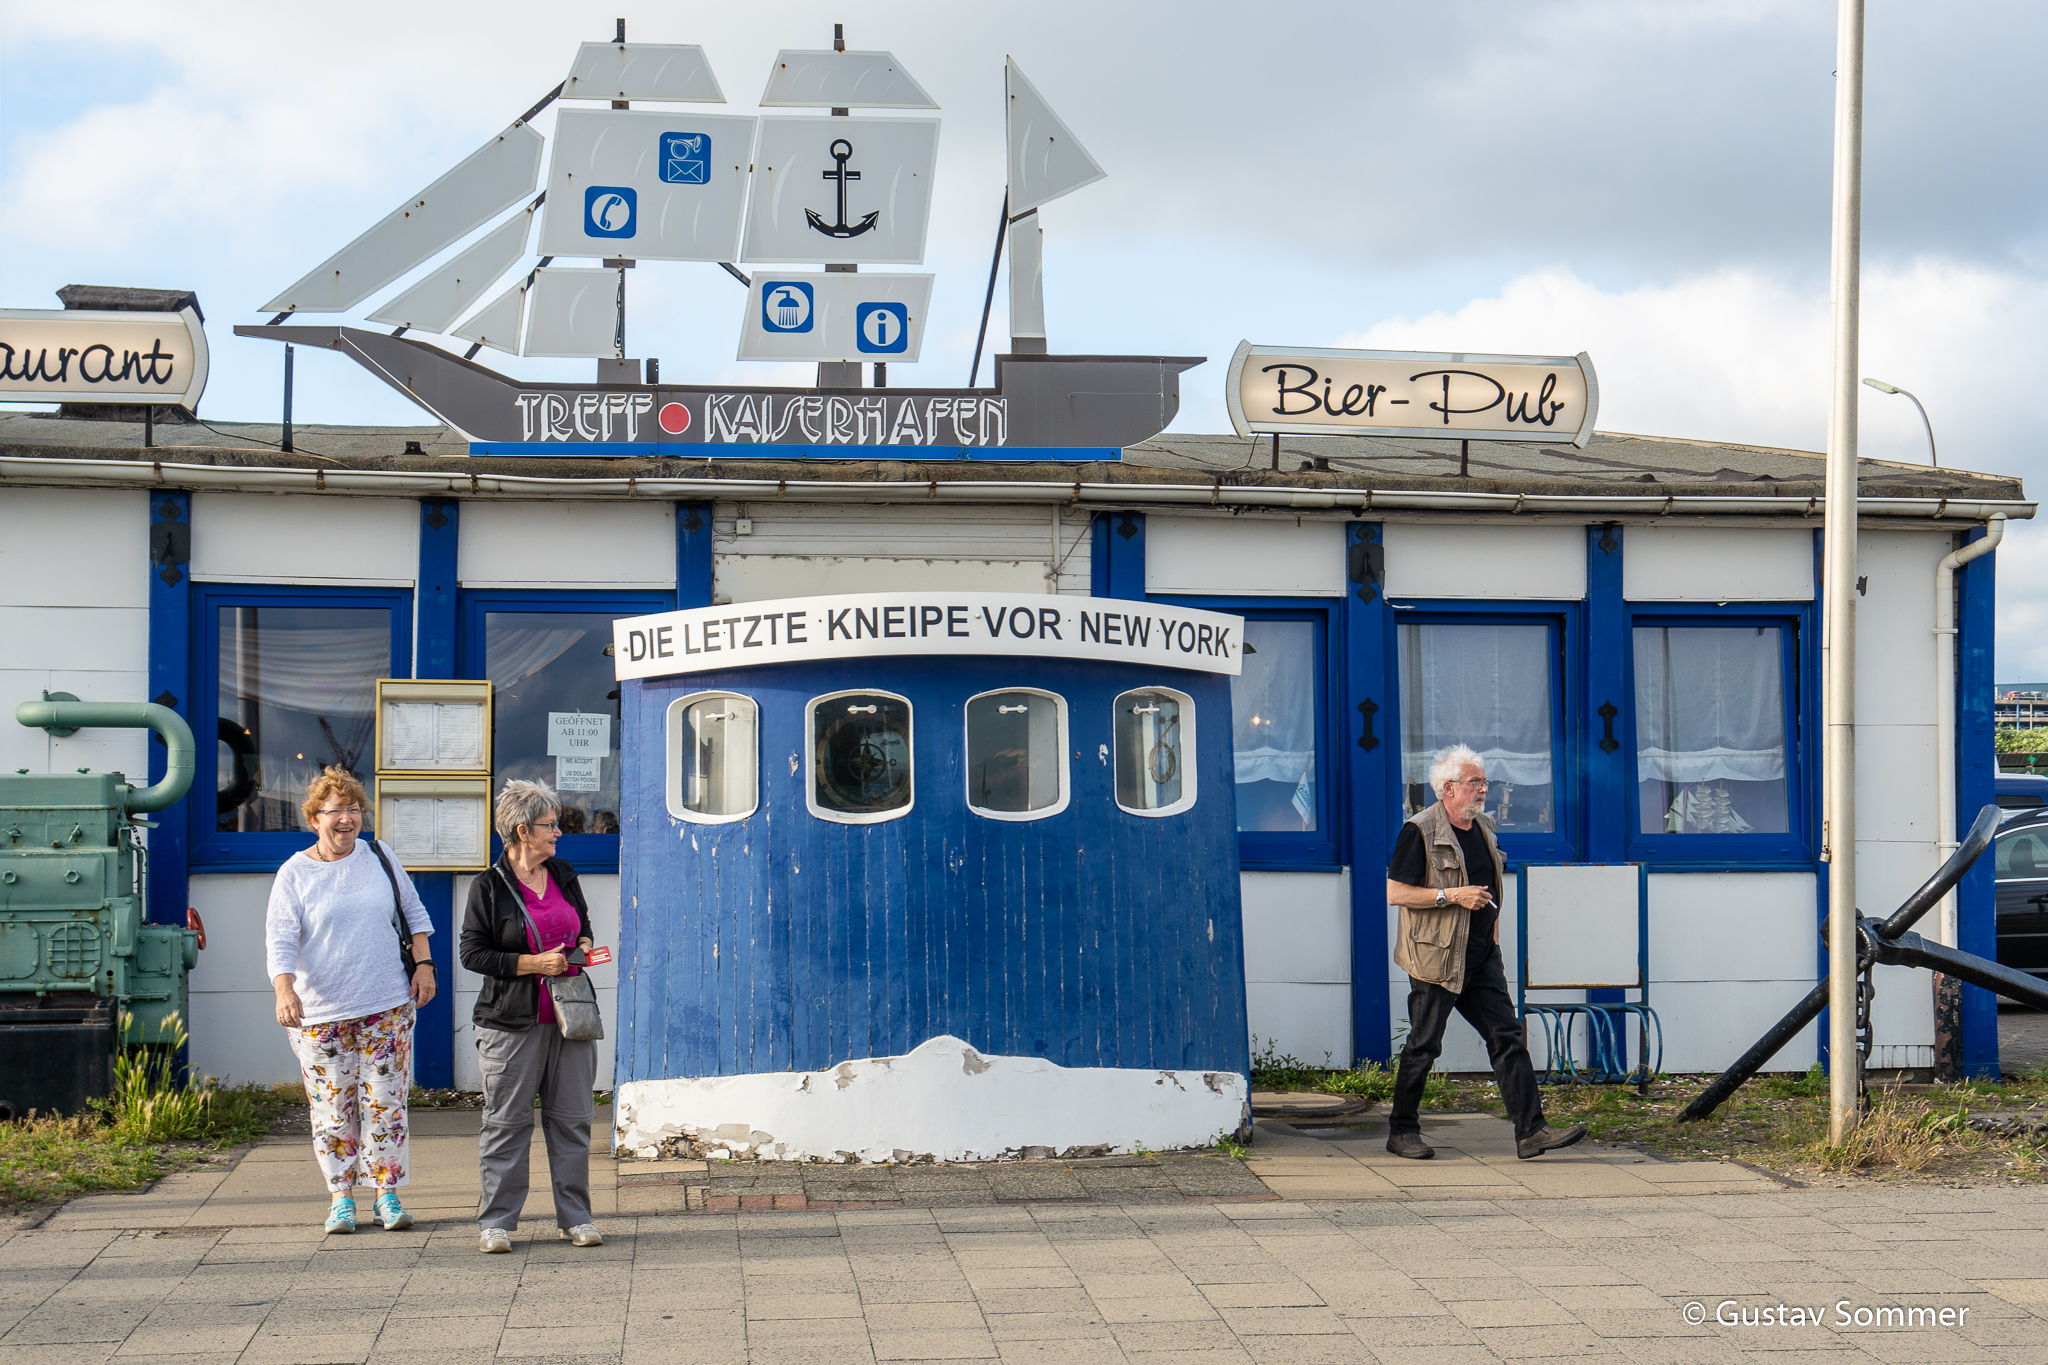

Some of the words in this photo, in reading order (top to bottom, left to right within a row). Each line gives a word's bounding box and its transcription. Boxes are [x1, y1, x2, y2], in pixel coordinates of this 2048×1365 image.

[515, 393, 653, 442] TREFF
[704, 394, 1009, 447] KAISERHAFEN
[628, 625, 674, 662] DIE
[684, 611, 808, 654] LETZTE
[828, 606, 970, 641] KNEIPE
[982, 605, 1062, 641] VOR
[1080, 611, 1152, 648] NEW
[1158, 619, 1232, 659] YORK
[556, 716, 604, 726] GEÖFFNET
[561, 728, 575, 736] AB
[577, 728, 599, 736] 11:00
[569, 739, 590, 747] UHR
